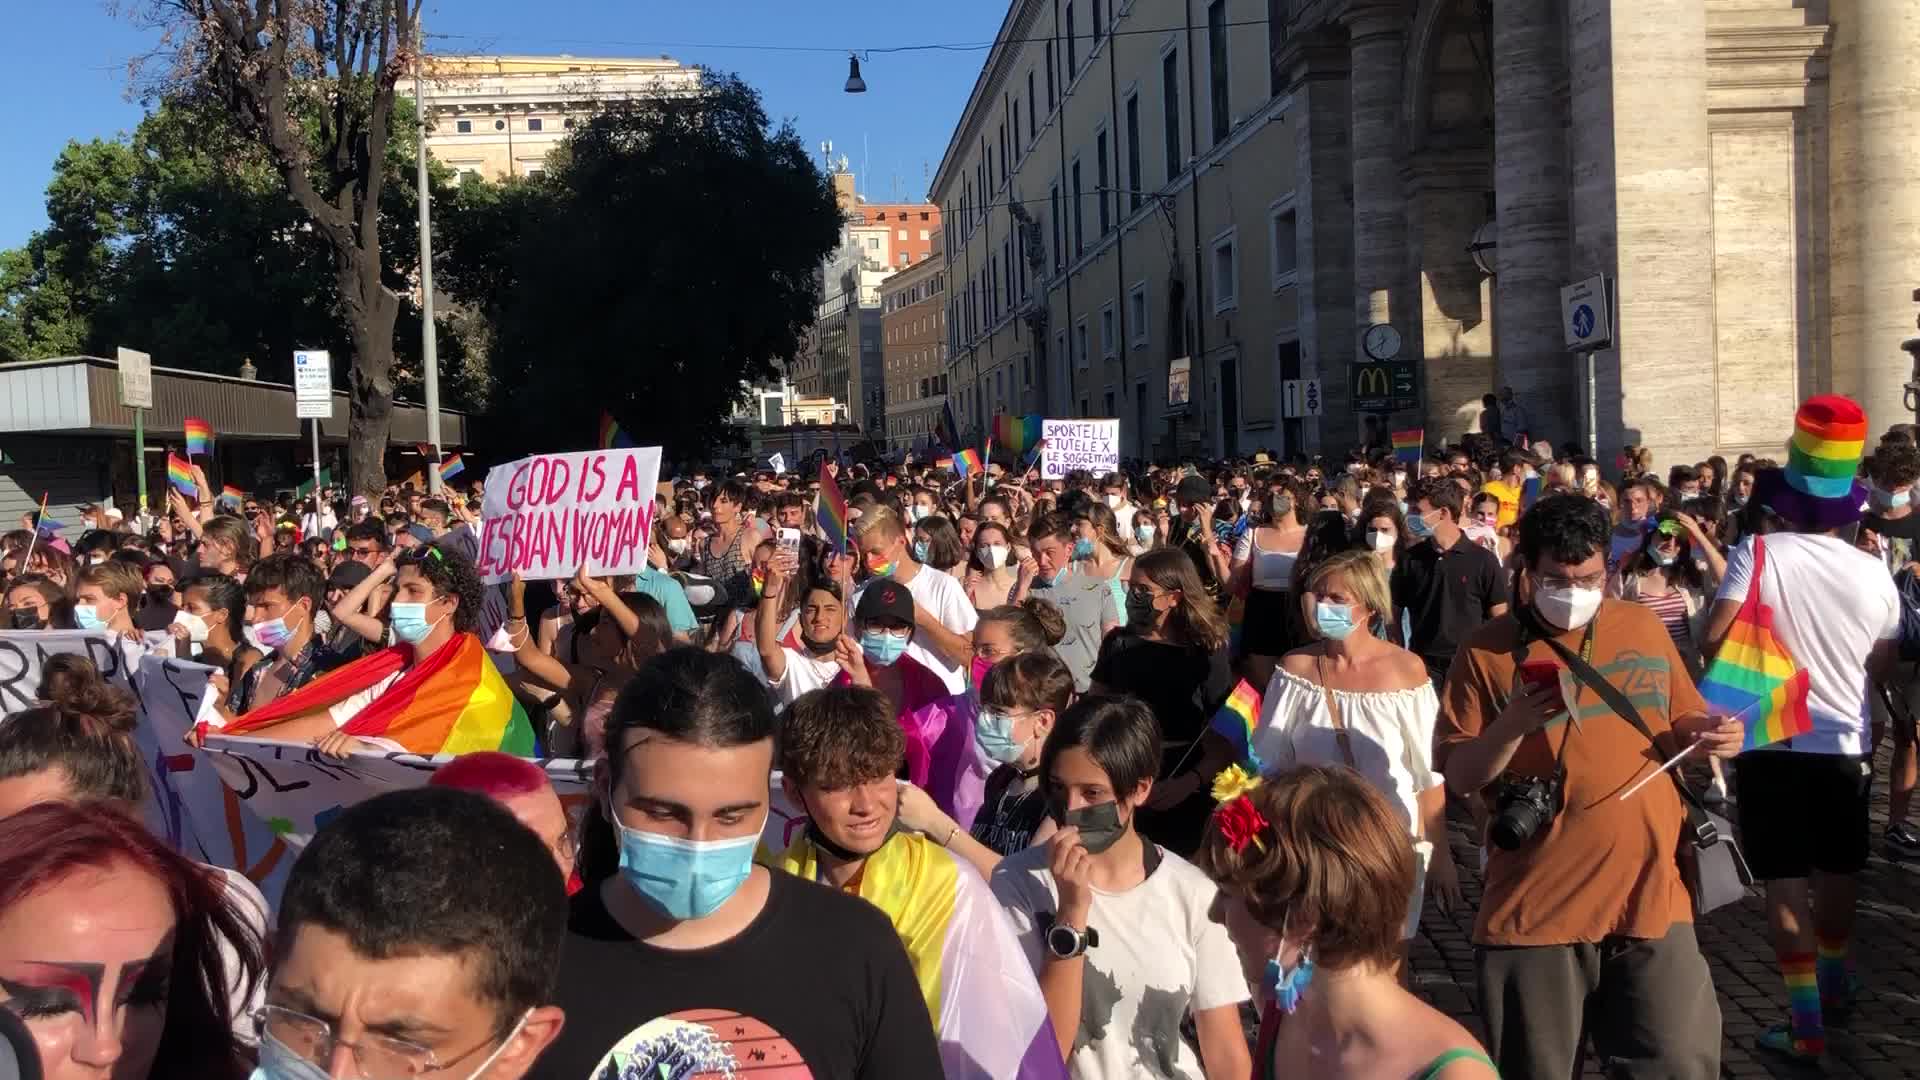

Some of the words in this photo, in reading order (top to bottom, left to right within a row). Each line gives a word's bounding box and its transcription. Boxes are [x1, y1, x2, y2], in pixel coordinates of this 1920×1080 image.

[1047, 423, 1113, 440] SPORTELLI
[1046, 438, 1053, 449] E
[1055, 438, 1097, 452] TUTELE
[1102, 441, 1110, 453] X
[1047, 452, 1059, 462] LE
[506, 457, 570, 511] GOD
[577, 455, 607, 503] IS
[615, 454, 639, 502] A
[479, 507, 569, 577] LESBIAN
[572, 499, 656, 569] WOMAN
